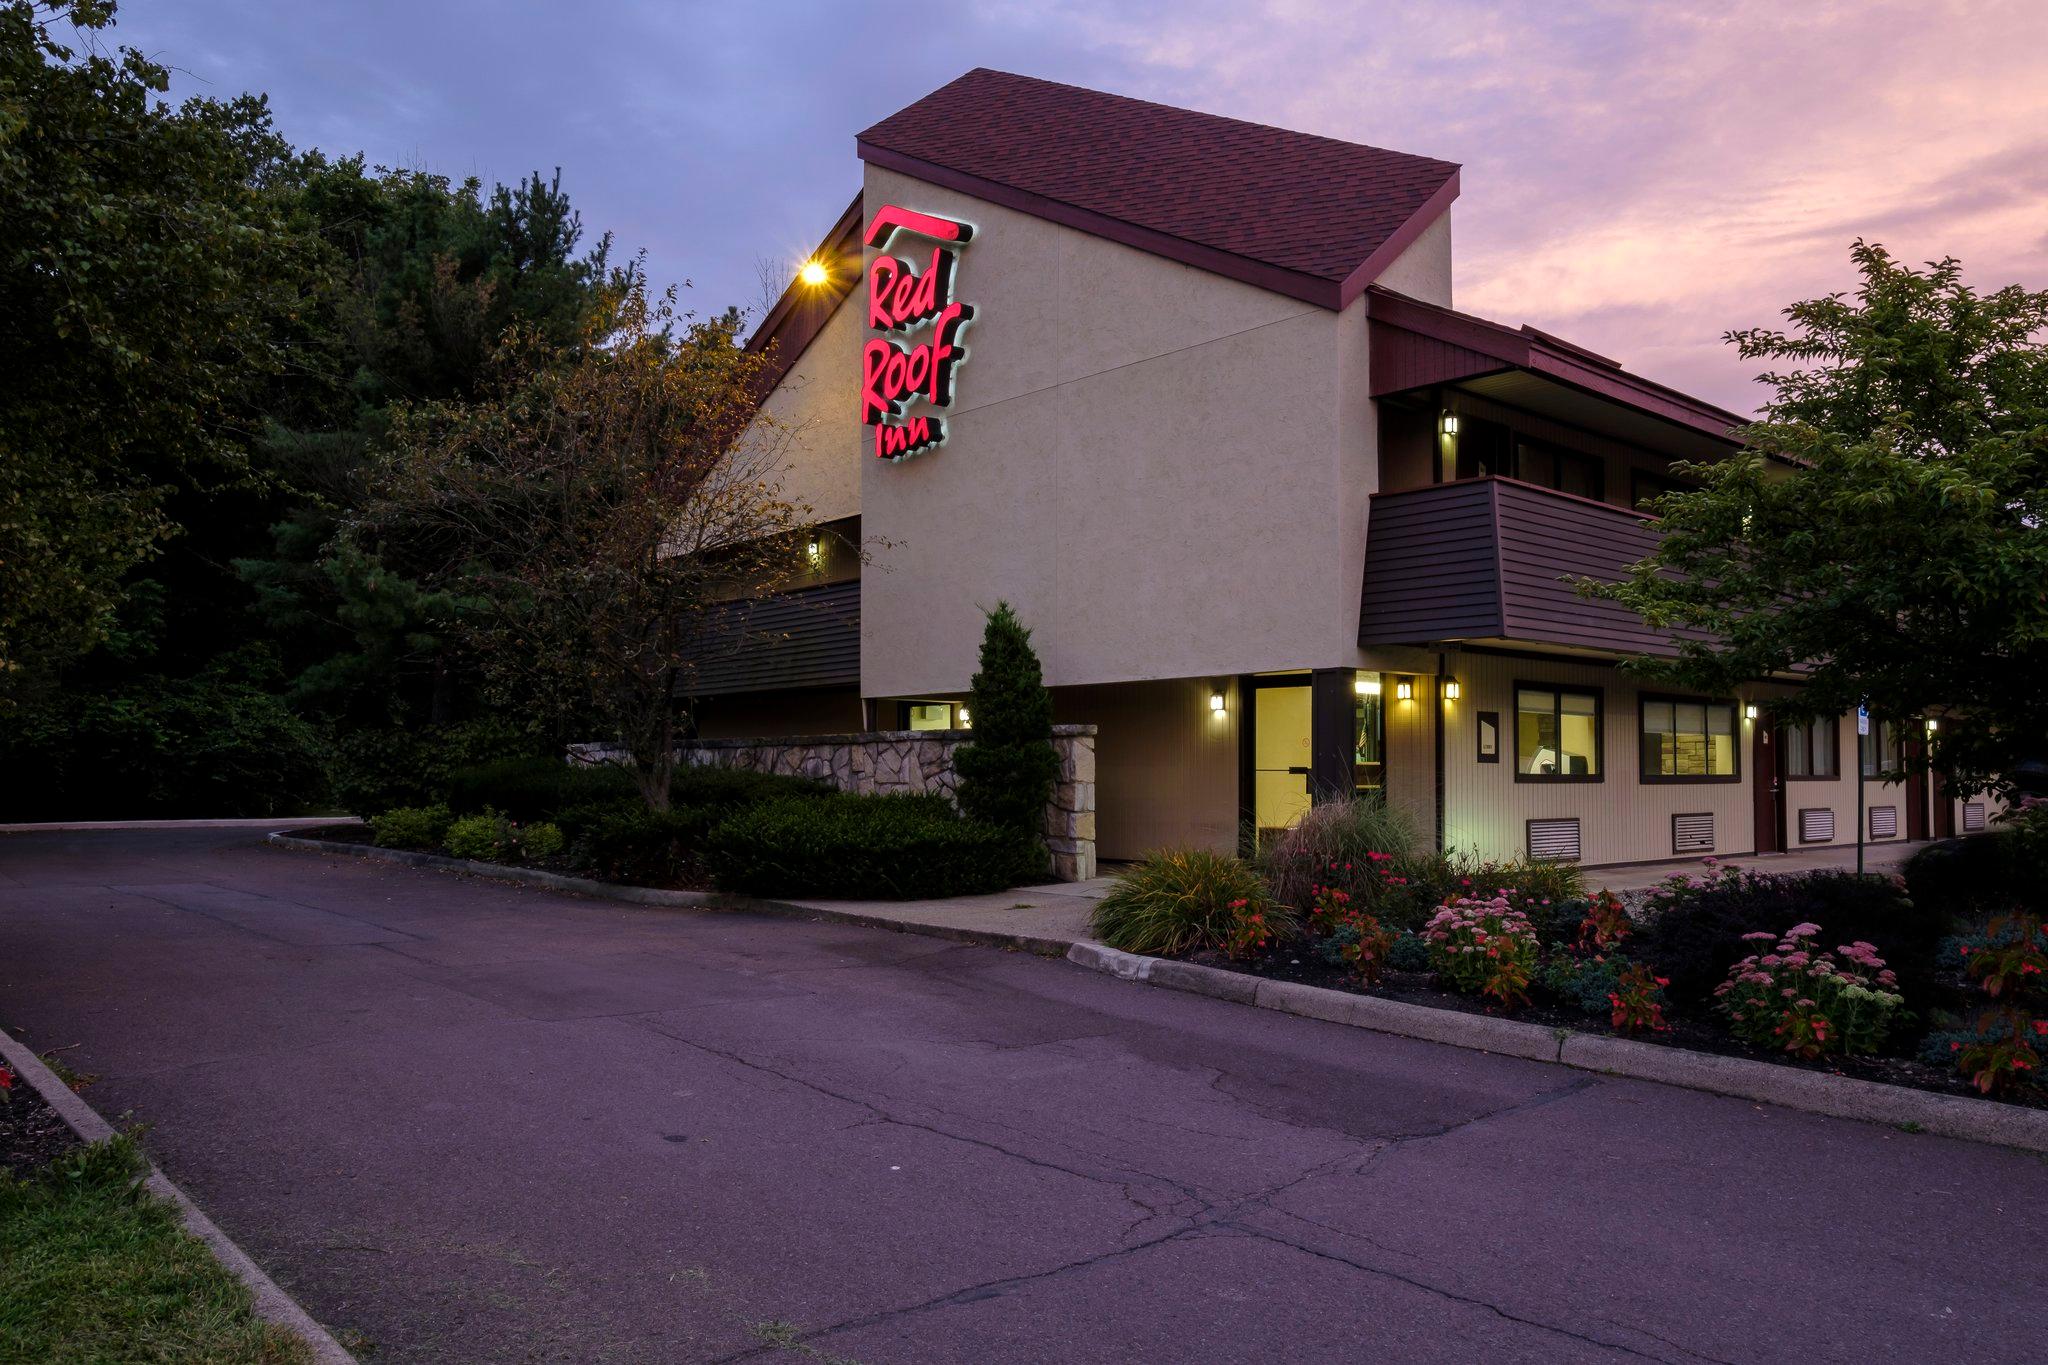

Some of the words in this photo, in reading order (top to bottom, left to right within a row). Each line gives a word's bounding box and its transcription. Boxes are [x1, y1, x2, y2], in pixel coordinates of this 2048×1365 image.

[870, 247, 941, 329] Red
[861, 302, 961, 425] Roof
[876, 416, 930, 458] Inn
